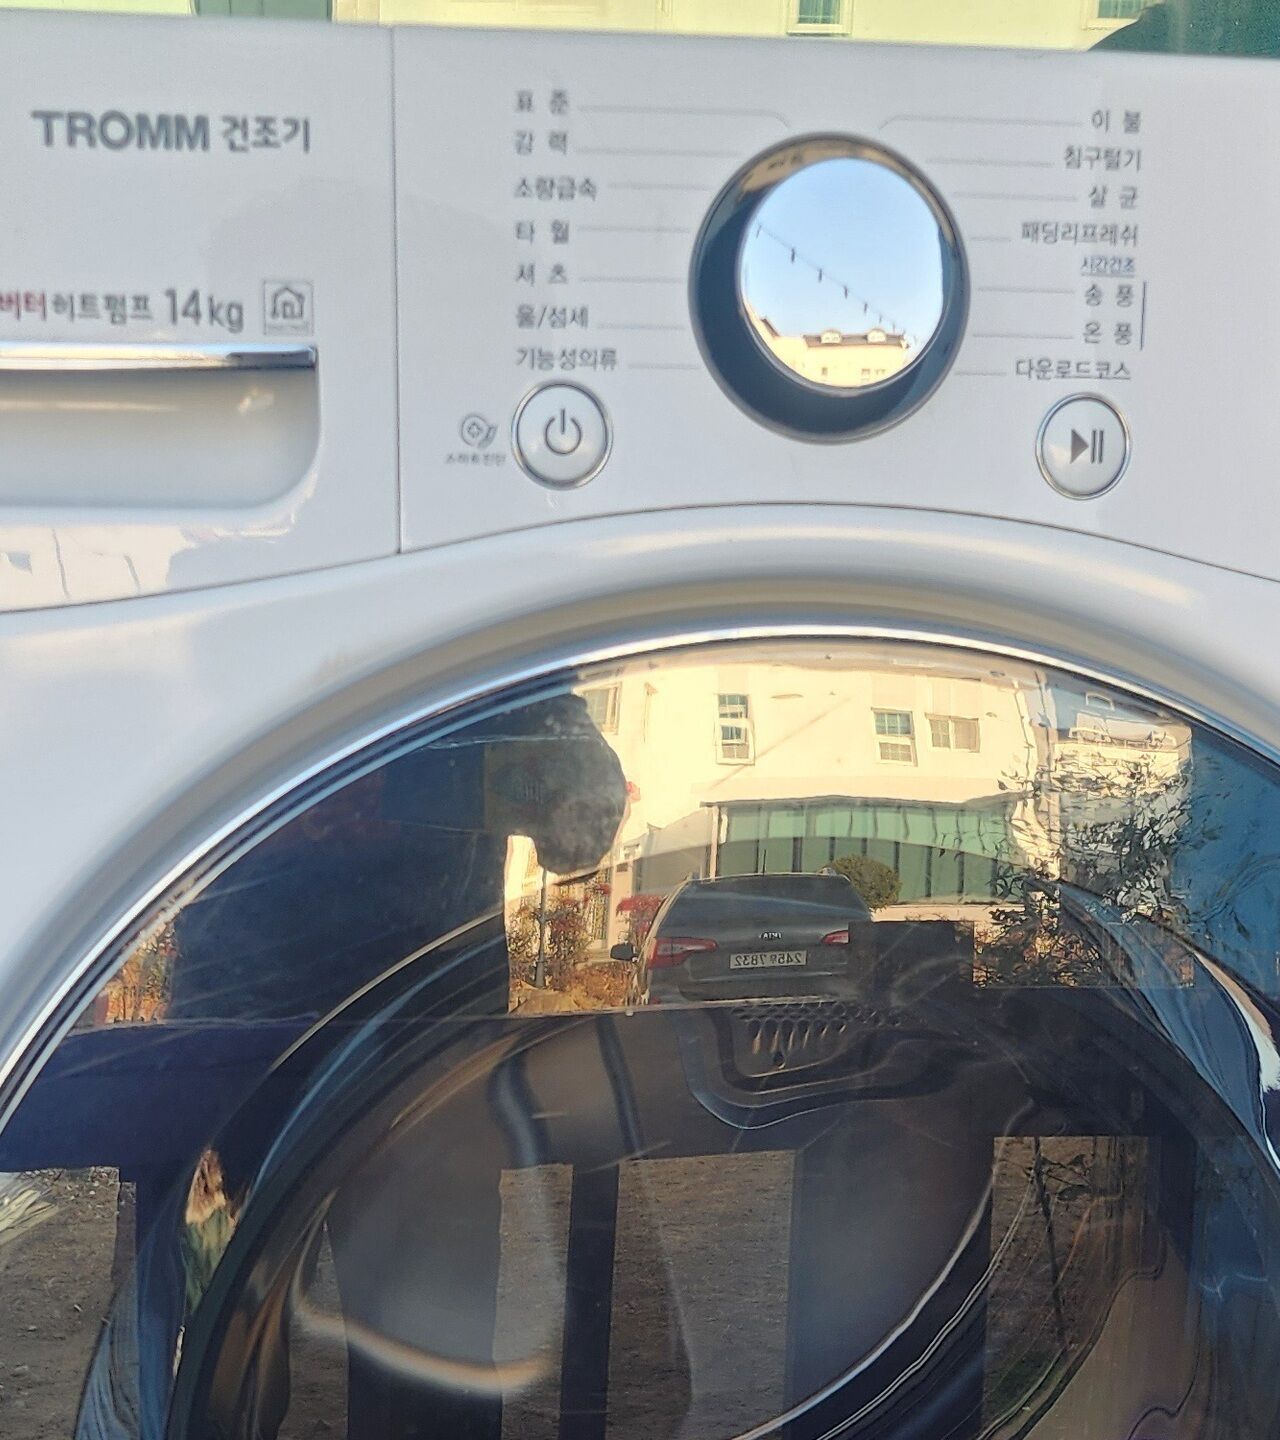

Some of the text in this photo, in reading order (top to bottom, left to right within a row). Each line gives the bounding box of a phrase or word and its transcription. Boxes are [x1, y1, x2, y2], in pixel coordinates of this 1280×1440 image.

[30, 109, 311, 153] TROMM 건조기
[1016, 358, 1132, 381] 다운로드코스
